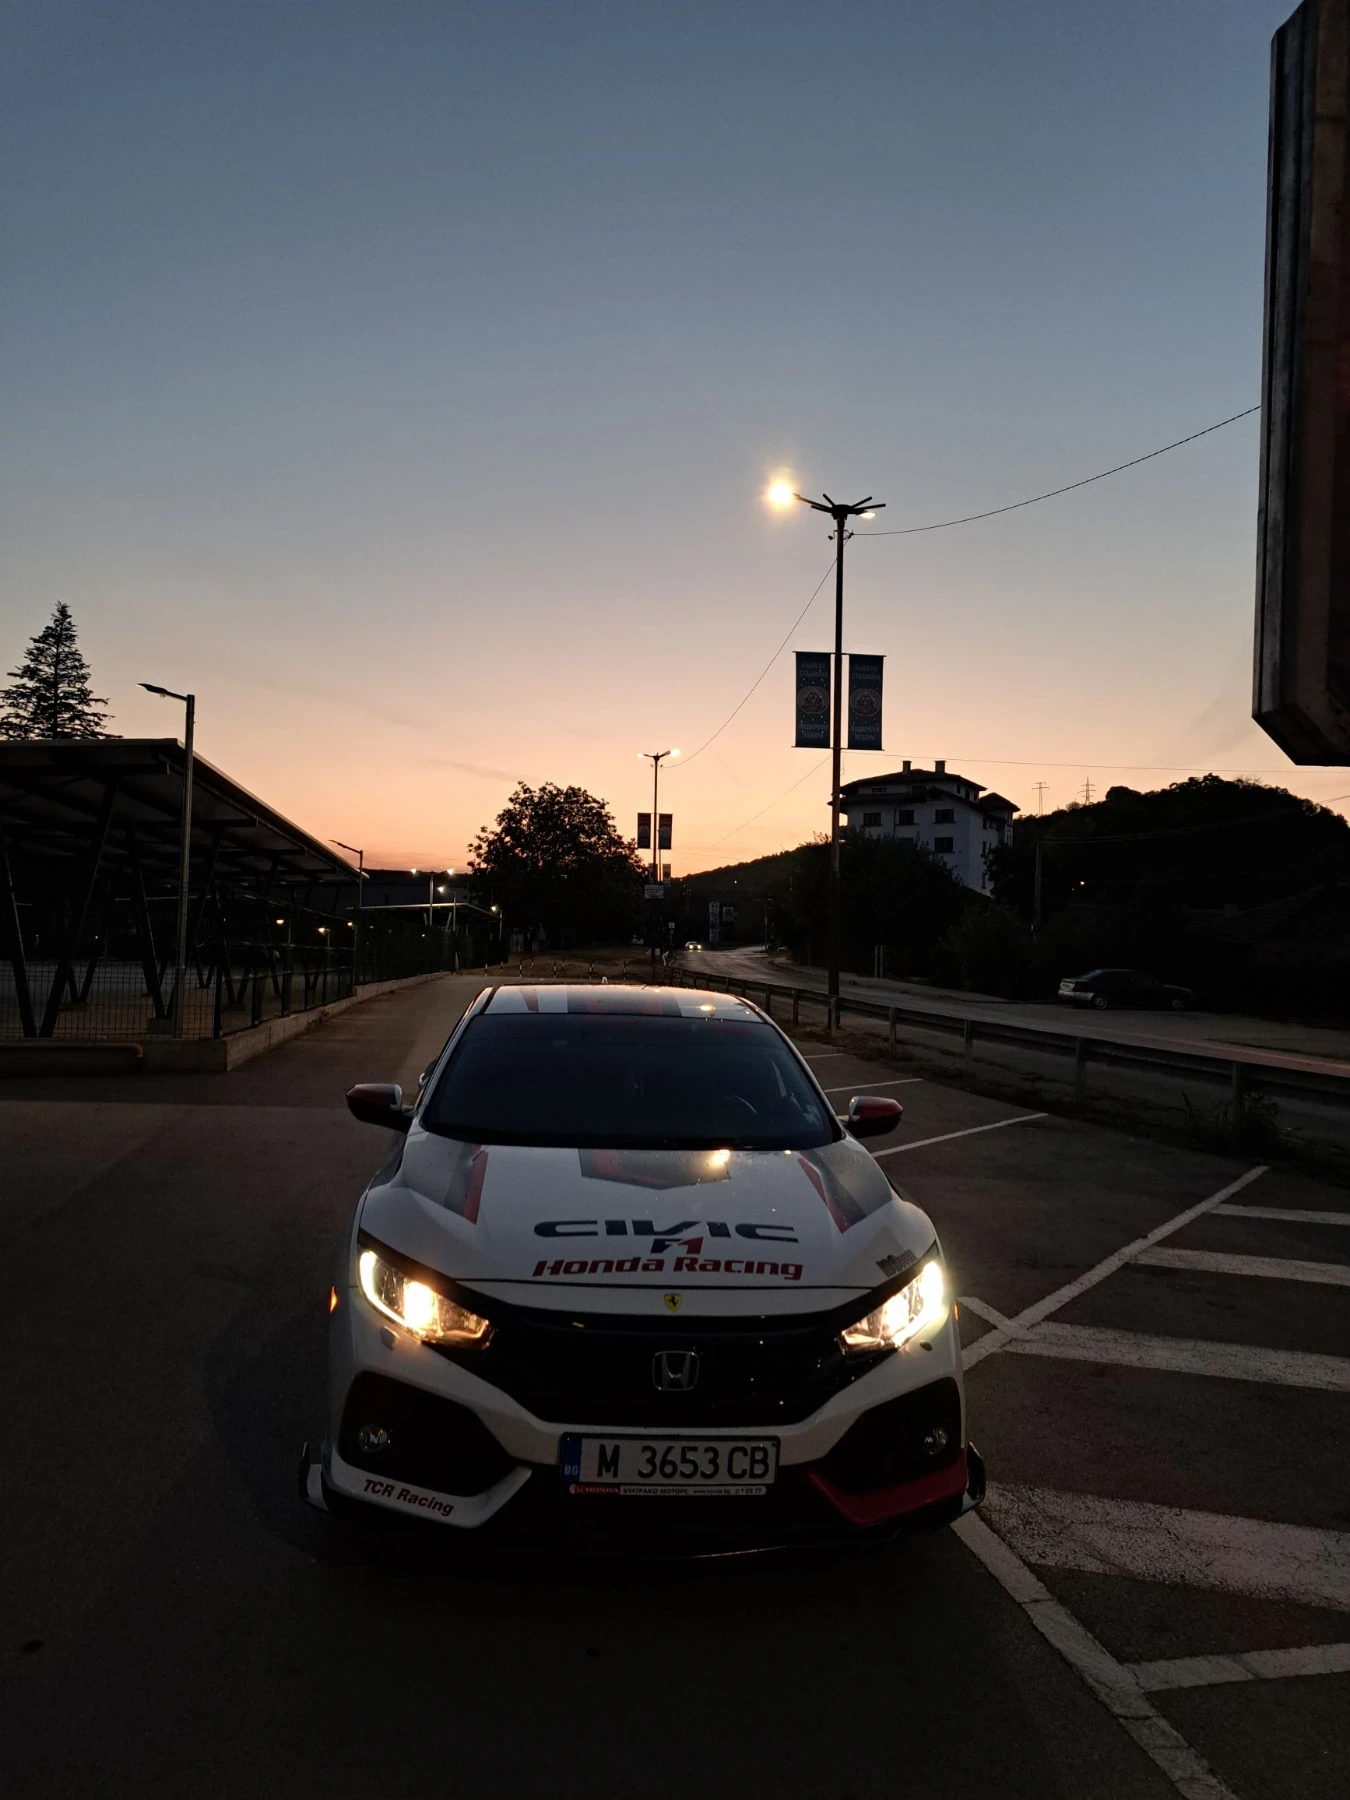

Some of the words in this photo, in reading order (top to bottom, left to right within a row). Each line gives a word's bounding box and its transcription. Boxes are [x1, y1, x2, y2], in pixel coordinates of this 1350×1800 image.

[533, 1220, 799, 1243] CIVIC
[532, 1257, 665, 1277] Honda
[673, 1257, 803, 1281] Racing
[563, 1465, 579, 1476] BG
[363, 1479, 396, 1497] TCR
[397, 1489, 455, 1516] Racing
